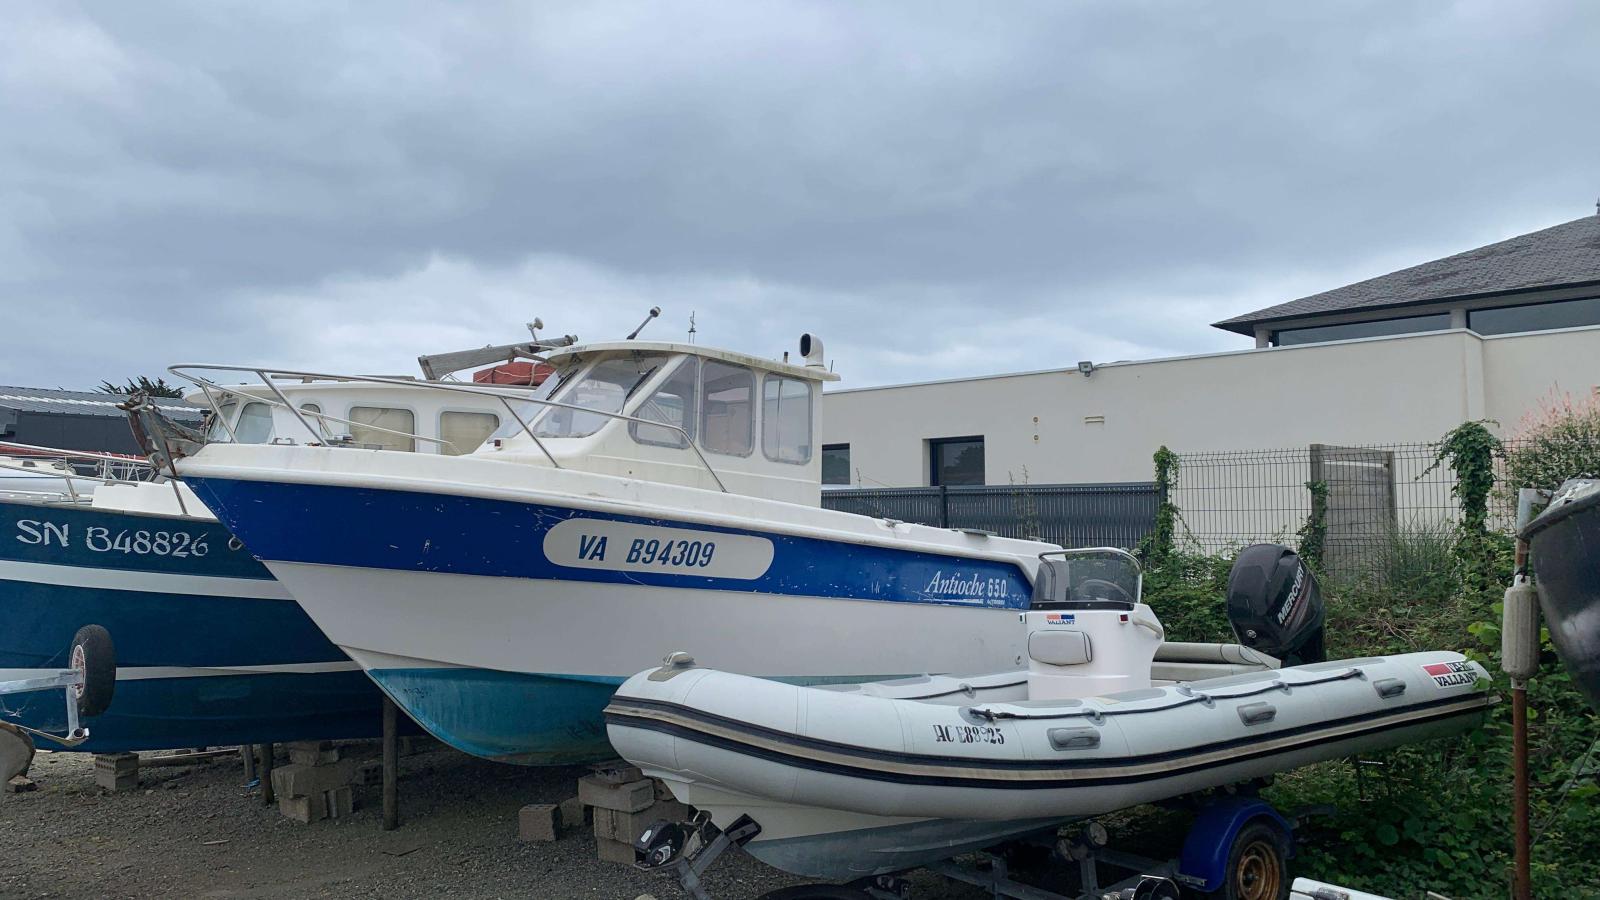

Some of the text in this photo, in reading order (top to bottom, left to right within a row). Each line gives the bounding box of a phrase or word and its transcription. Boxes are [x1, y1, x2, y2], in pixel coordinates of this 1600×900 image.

[16, 519, 208, 557] SN B48826
[578, 534, 715, 567] VA B94309
[925, 570, 1007, 598] Antioche 650
[1277, 562, 1304, 624] MERCURY
[932, 724, 955, 743] AC
